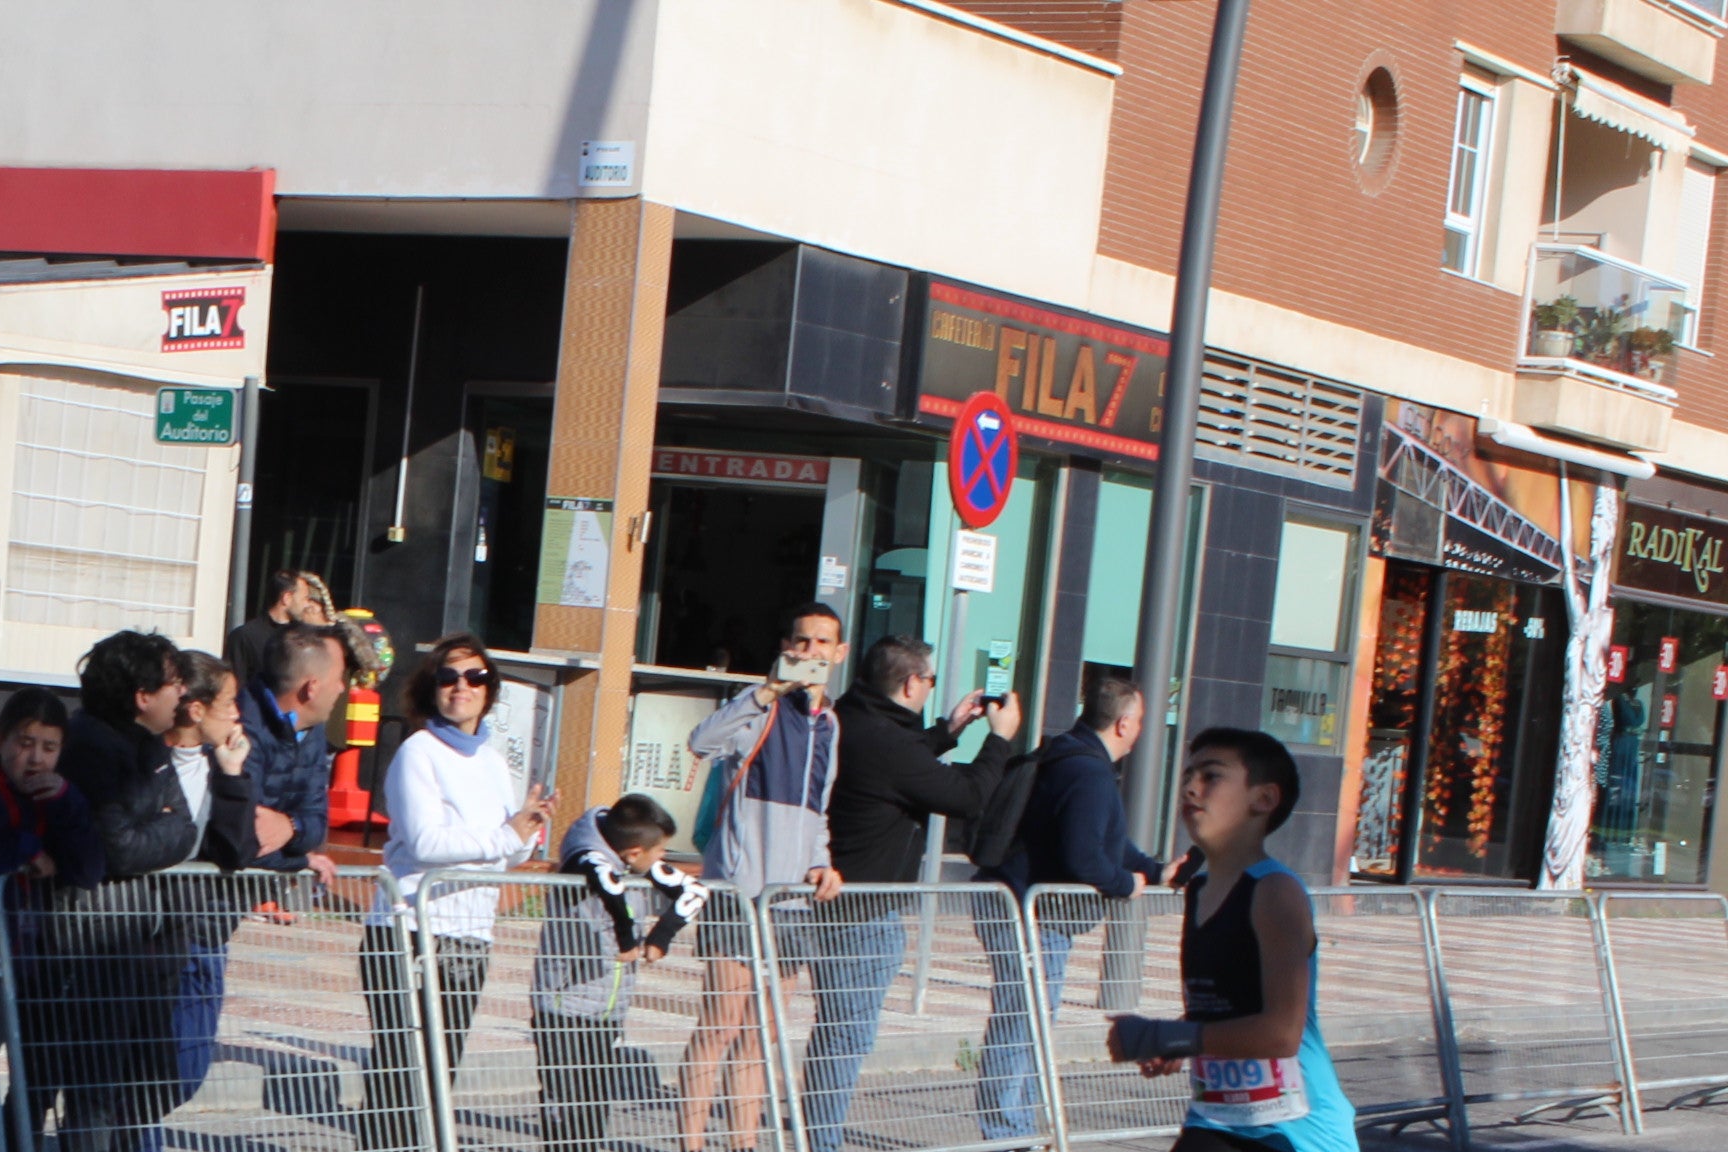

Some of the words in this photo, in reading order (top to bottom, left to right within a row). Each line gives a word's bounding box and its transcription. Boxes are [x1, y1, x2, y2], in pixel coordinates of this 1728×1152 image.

[183, 391, 224, 409] Pasaje
[192, 409, 209, 421] del
[159, 422, 229, 441] Auditorio
[658, 454, 818, 481] ENTRADA
[1627, 521, 1724, 593] RADIKAL
[1204, 1058, 1264, 1090] 909
